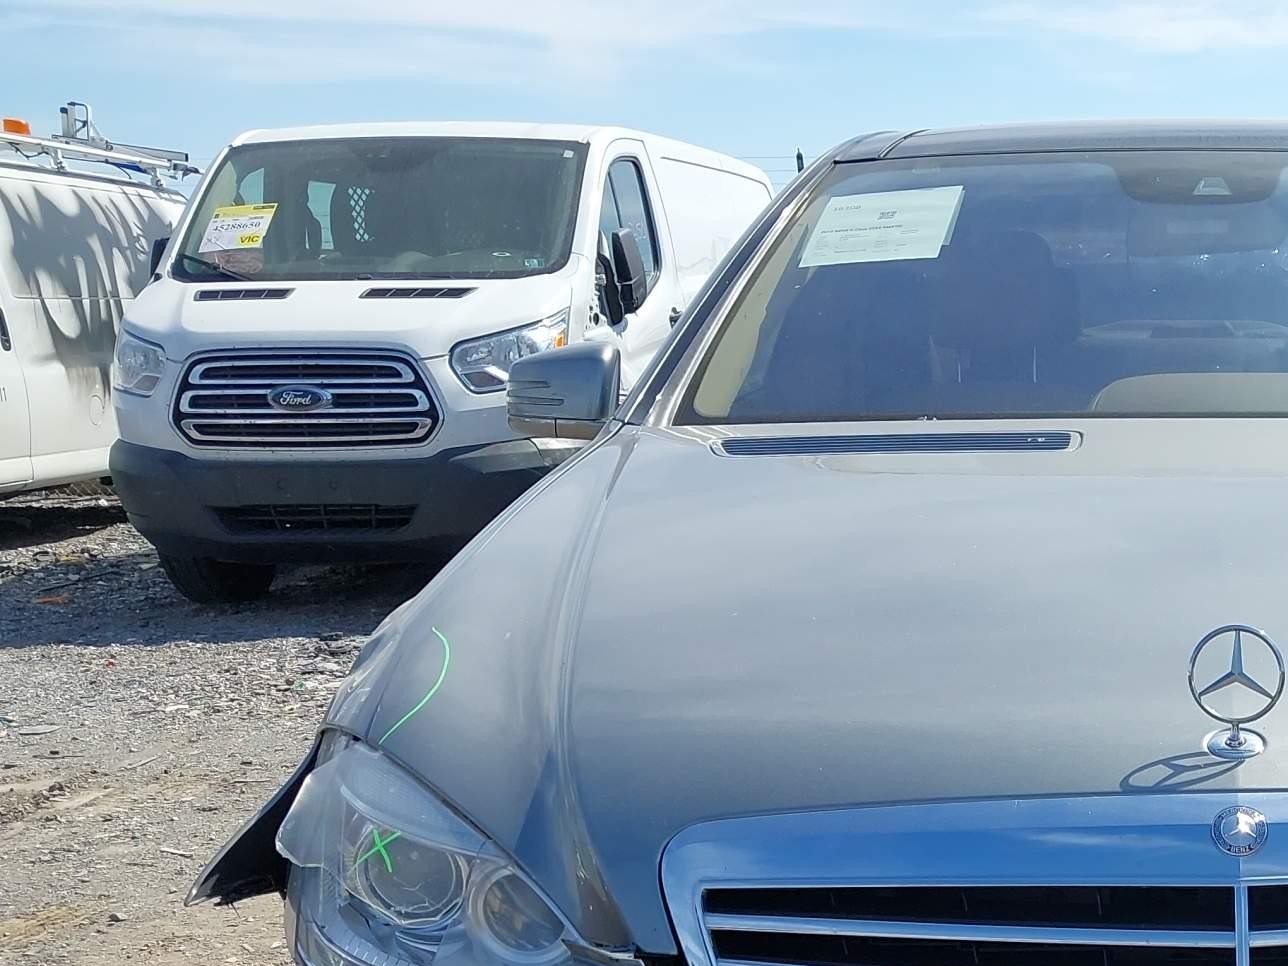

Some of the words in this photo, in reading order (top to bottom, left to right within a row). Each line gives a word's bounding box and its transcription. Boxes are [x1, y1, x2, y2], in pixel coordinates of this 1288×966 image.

[213, 221, 261, 232] 45288650
[240, 235, 260, 244] VIC
[280, 391, 312, 405] Ford
